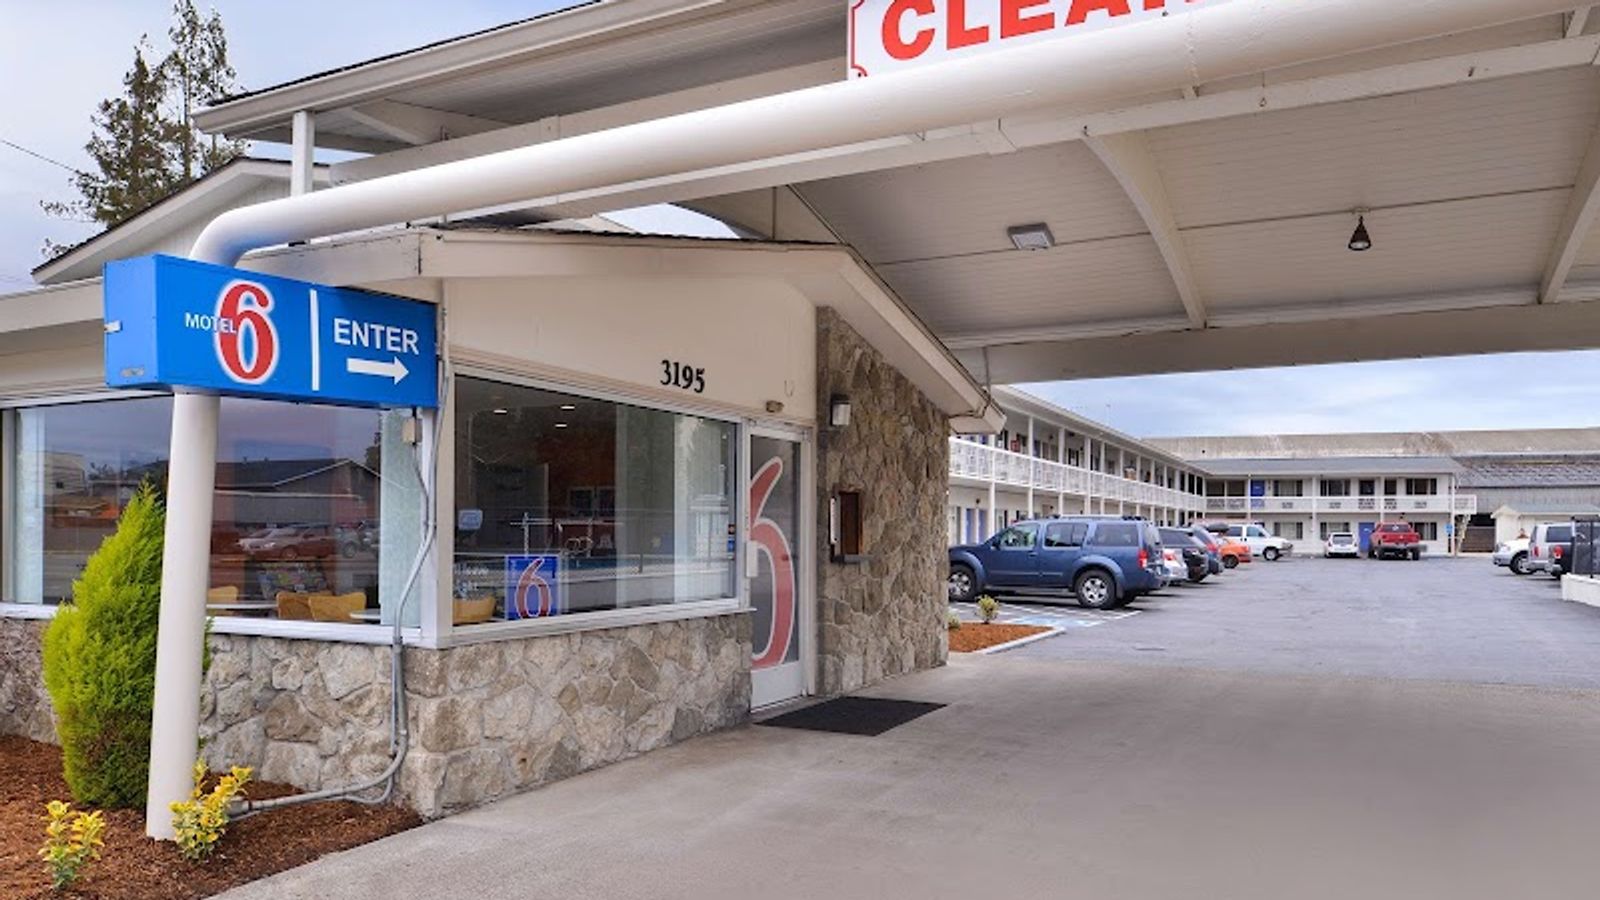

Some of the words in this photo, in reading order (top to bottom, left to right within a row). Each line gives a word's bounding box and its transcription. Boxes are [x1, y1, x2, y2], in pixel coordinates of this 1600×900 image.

[184, 312, 238, 334] MOTEL
[214, 279, 279, 385] 6
[333, 317, 420, 355] ENTER
[660, 359, 706, 394] 3195
[514, 558, 551, 619] 6
